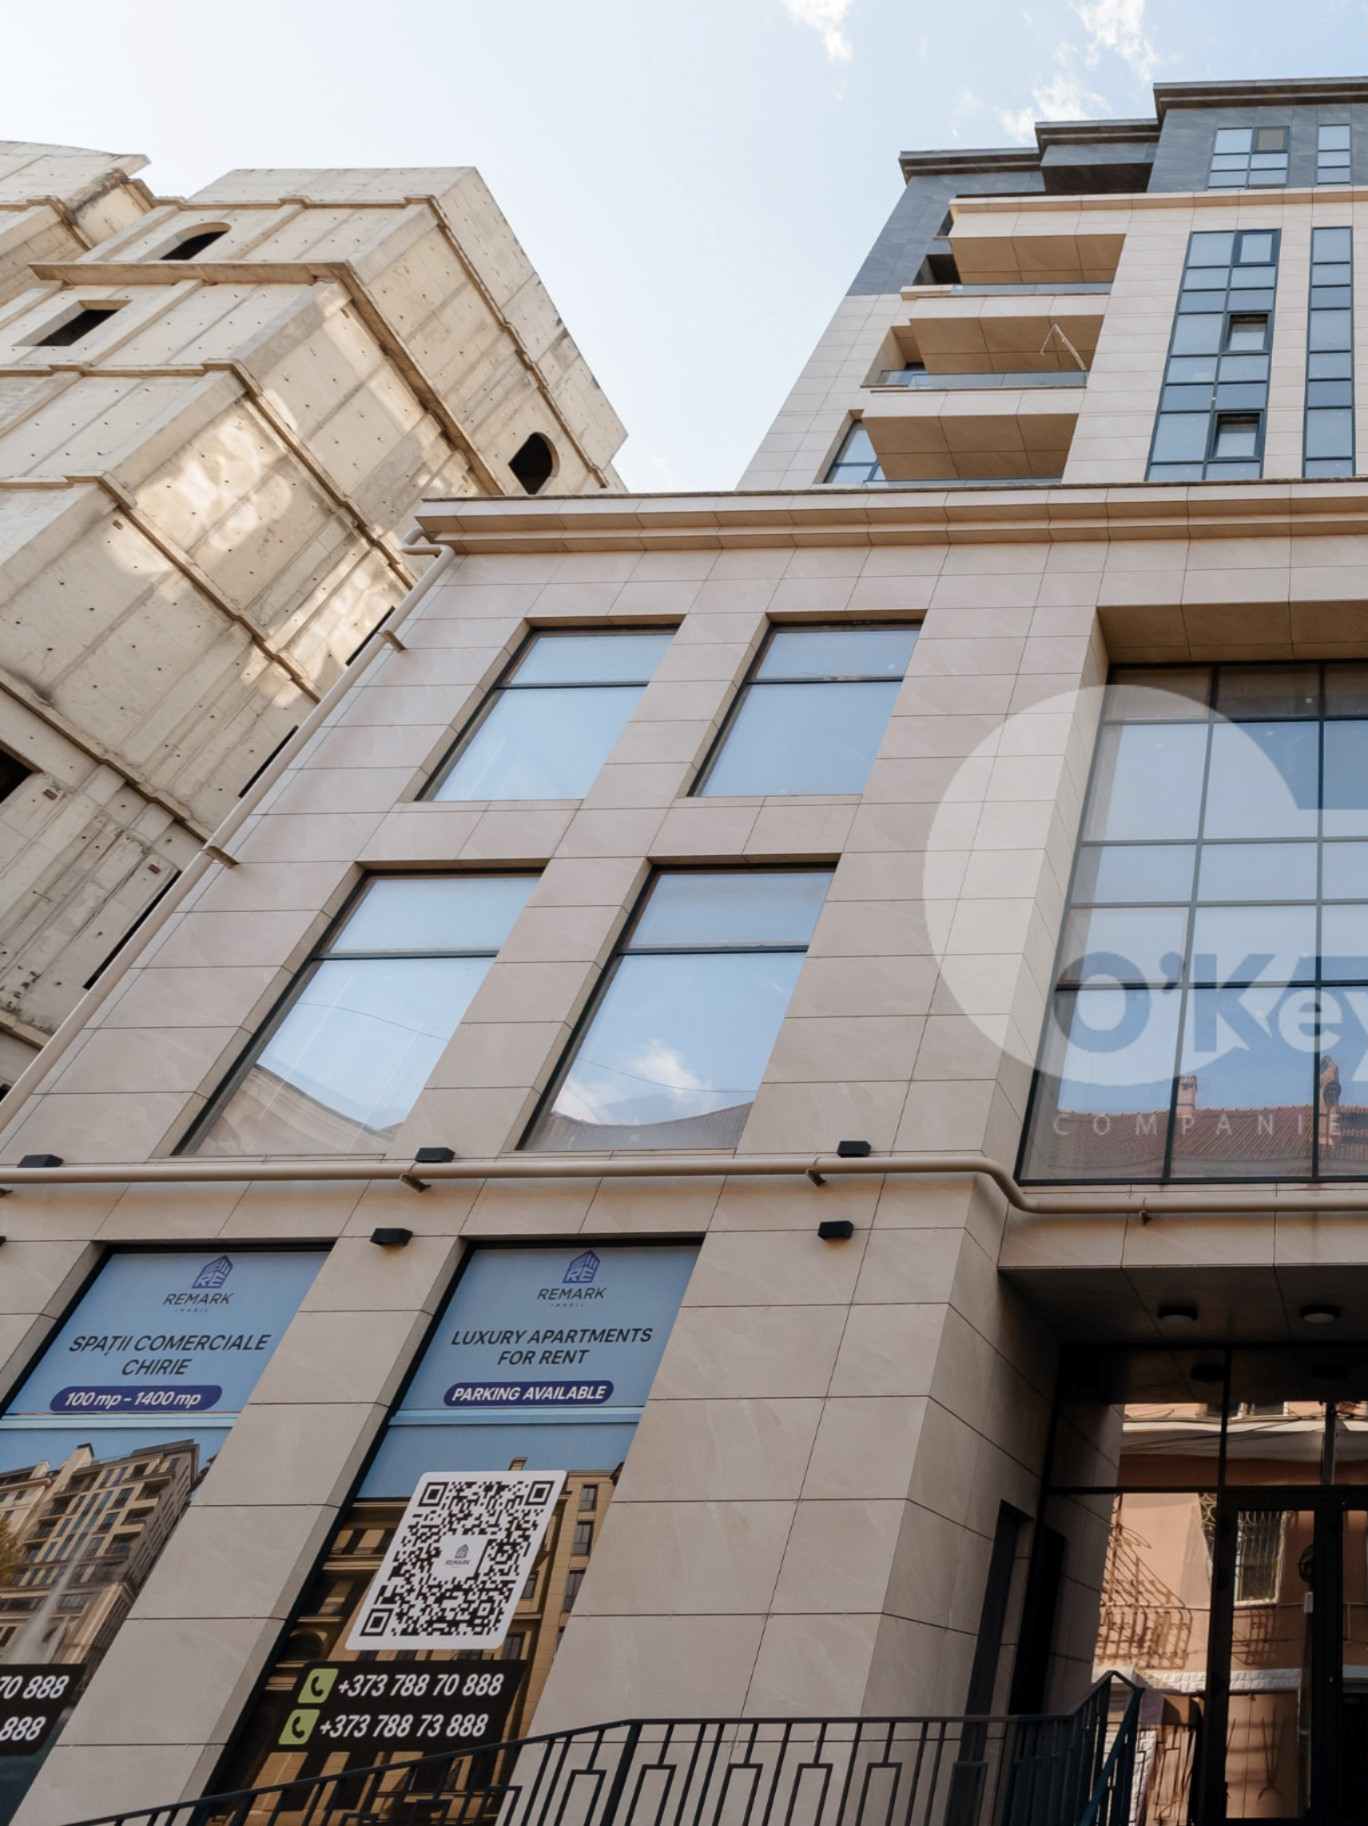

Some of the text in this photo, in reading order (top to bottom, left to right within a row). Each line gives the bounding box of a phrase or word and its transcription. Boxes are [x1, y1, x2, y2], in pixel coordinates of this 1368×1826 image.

[162, 1292, 235, 1306] REMARK
[536, 1287, 608, 1301] REMARK
[133, 1333, 272, 1352] COMERCIALE
[450, 1327, 654, 1346] LUXURY APARTMENTS
[121, 1358, 193, 1376] CHIRIE
[497, 1349, 591, 1366] FOR RENT
[64, 1391, 97, 1407] 100
[93, 1394, 121, 1410] mp
[133, 1391, 176, 1406] 1400
[172, 1393, 202, 1410] mp
[451, 1385, 608, 1402] PARKING AVAILABLE
[22, 1674, 71, 1700] 888
[337, 1672, 505, 1698] +373 788 70 888
[0, 1715, 47, 1742] 888
[319, 1712, 490, 1739] +373 788 73 888
